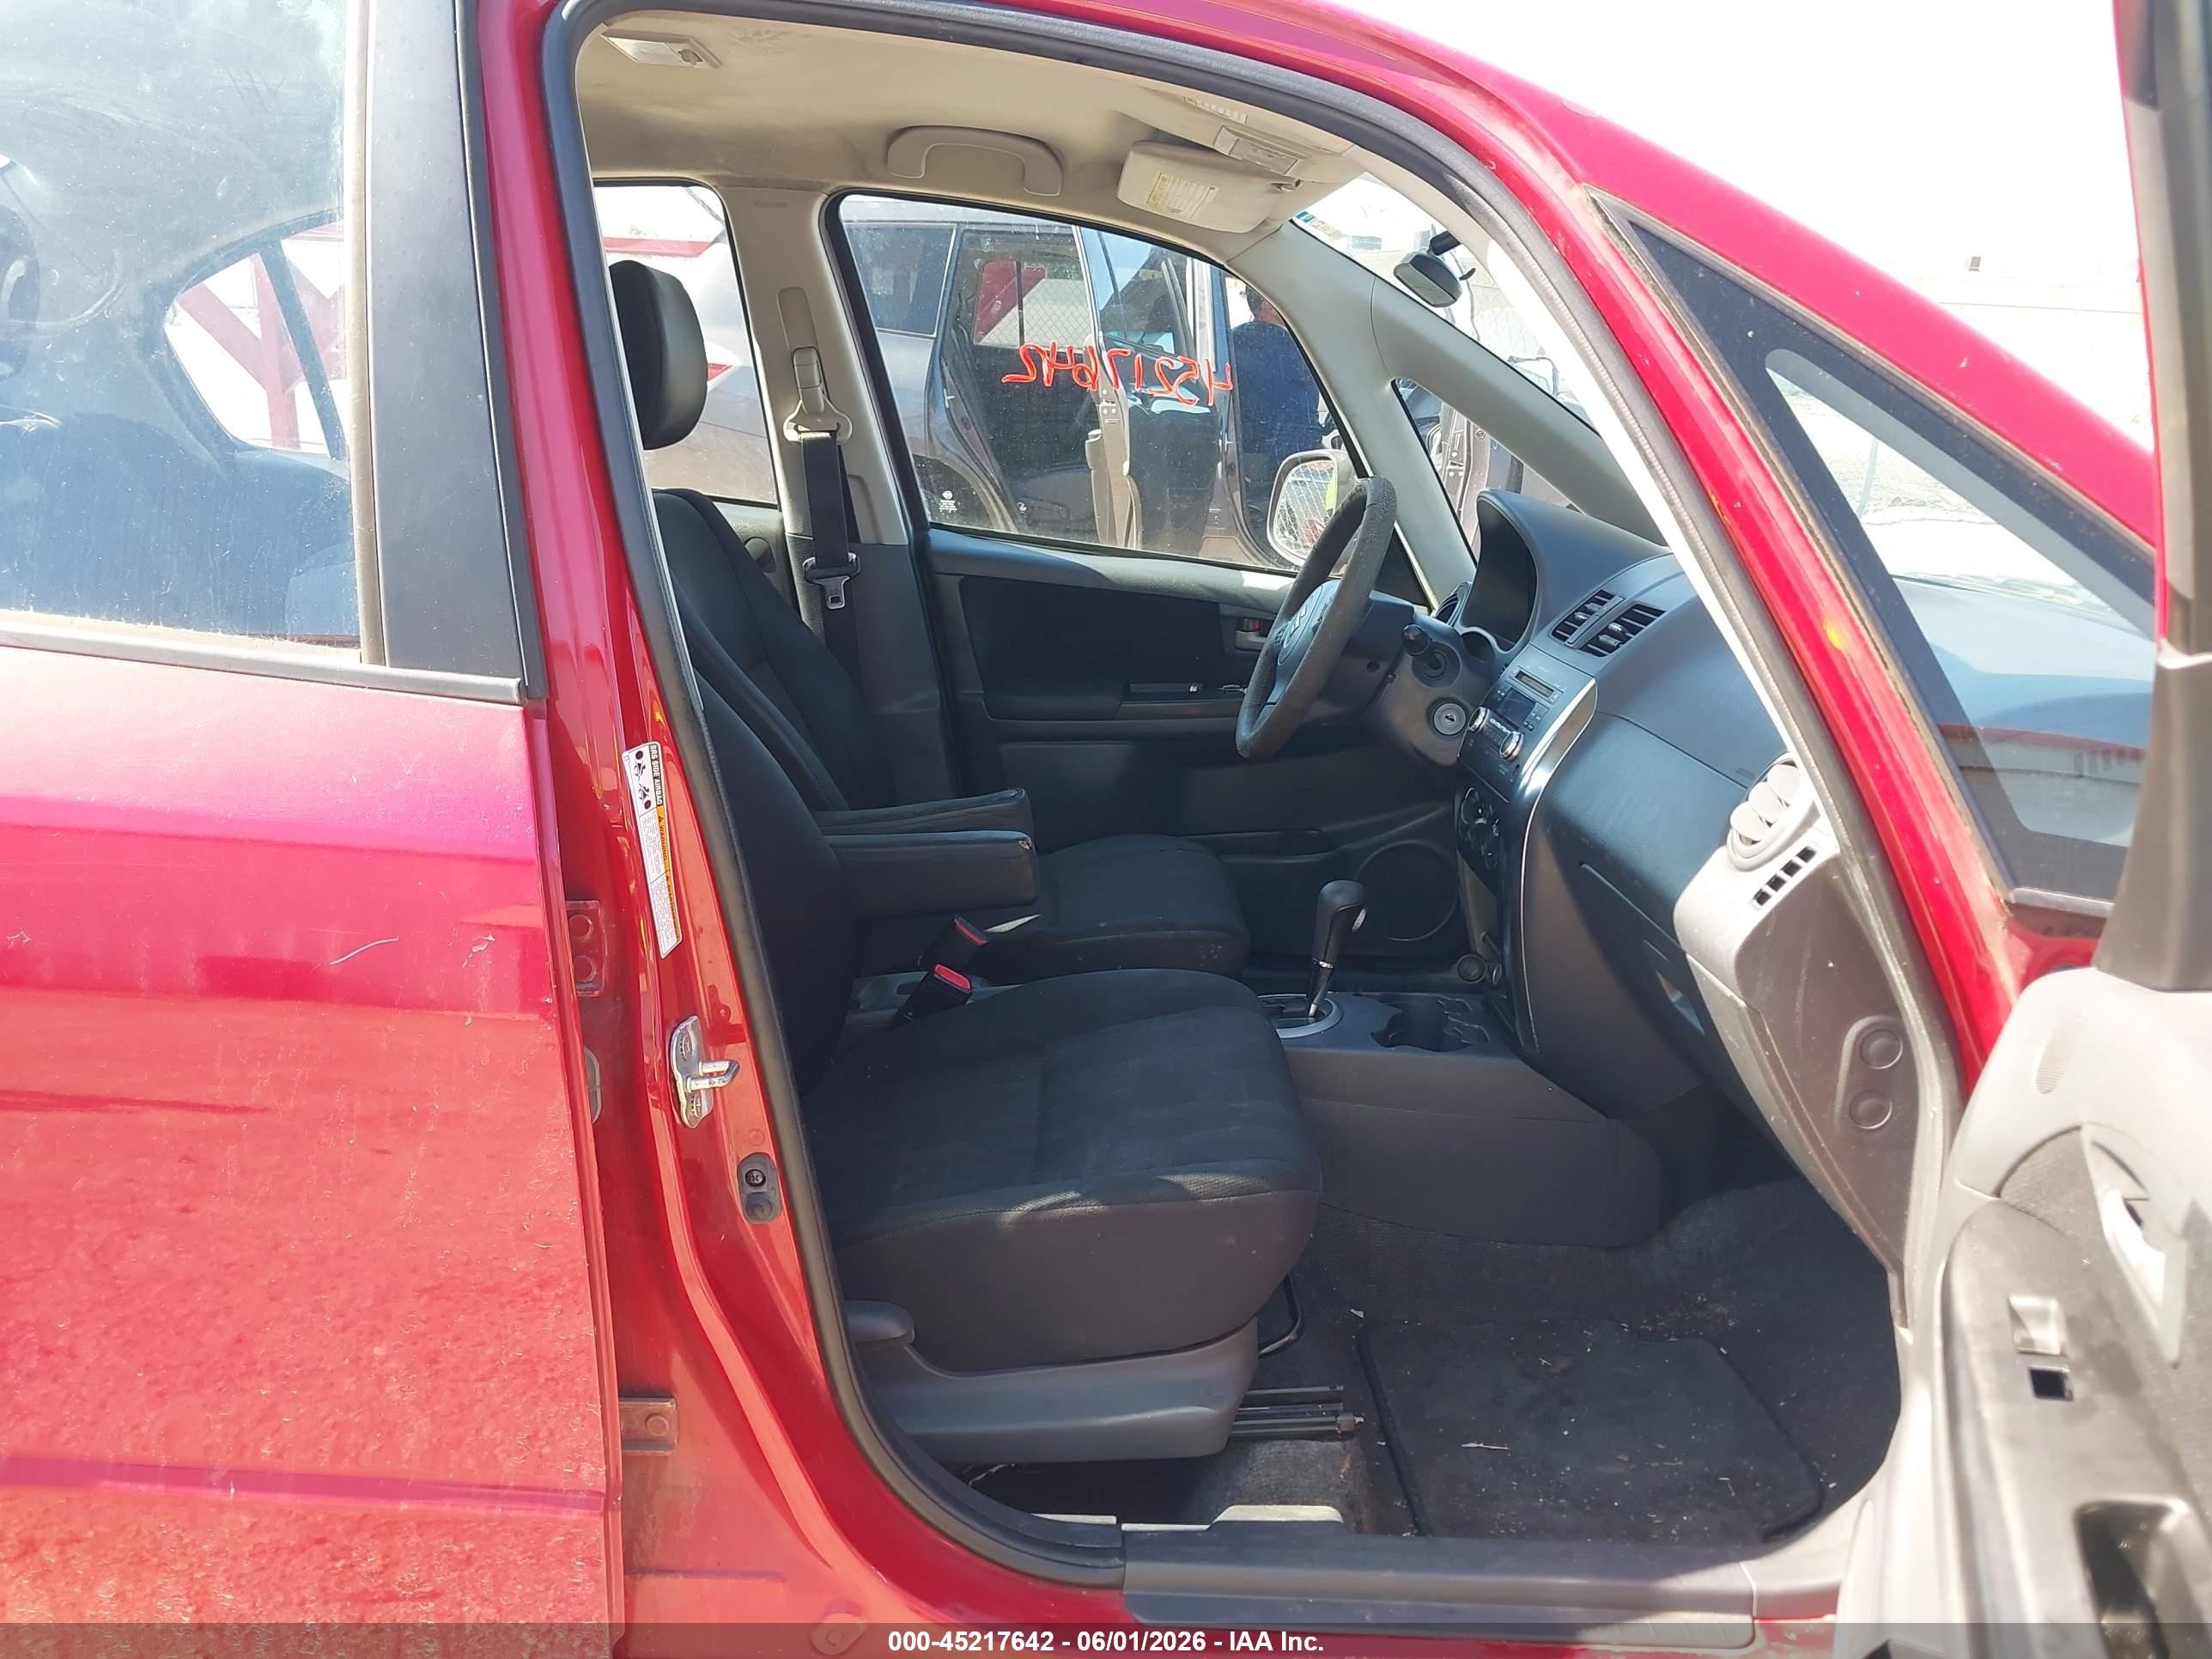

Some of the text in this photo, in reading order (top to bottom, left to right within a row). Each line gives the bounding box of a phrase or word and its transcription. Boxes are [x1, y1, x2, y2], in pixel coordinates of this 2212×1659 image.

[649, 744, 663, 805] SRS SIDE AIRBAG
[659, 824, 668, 860] WARNING
